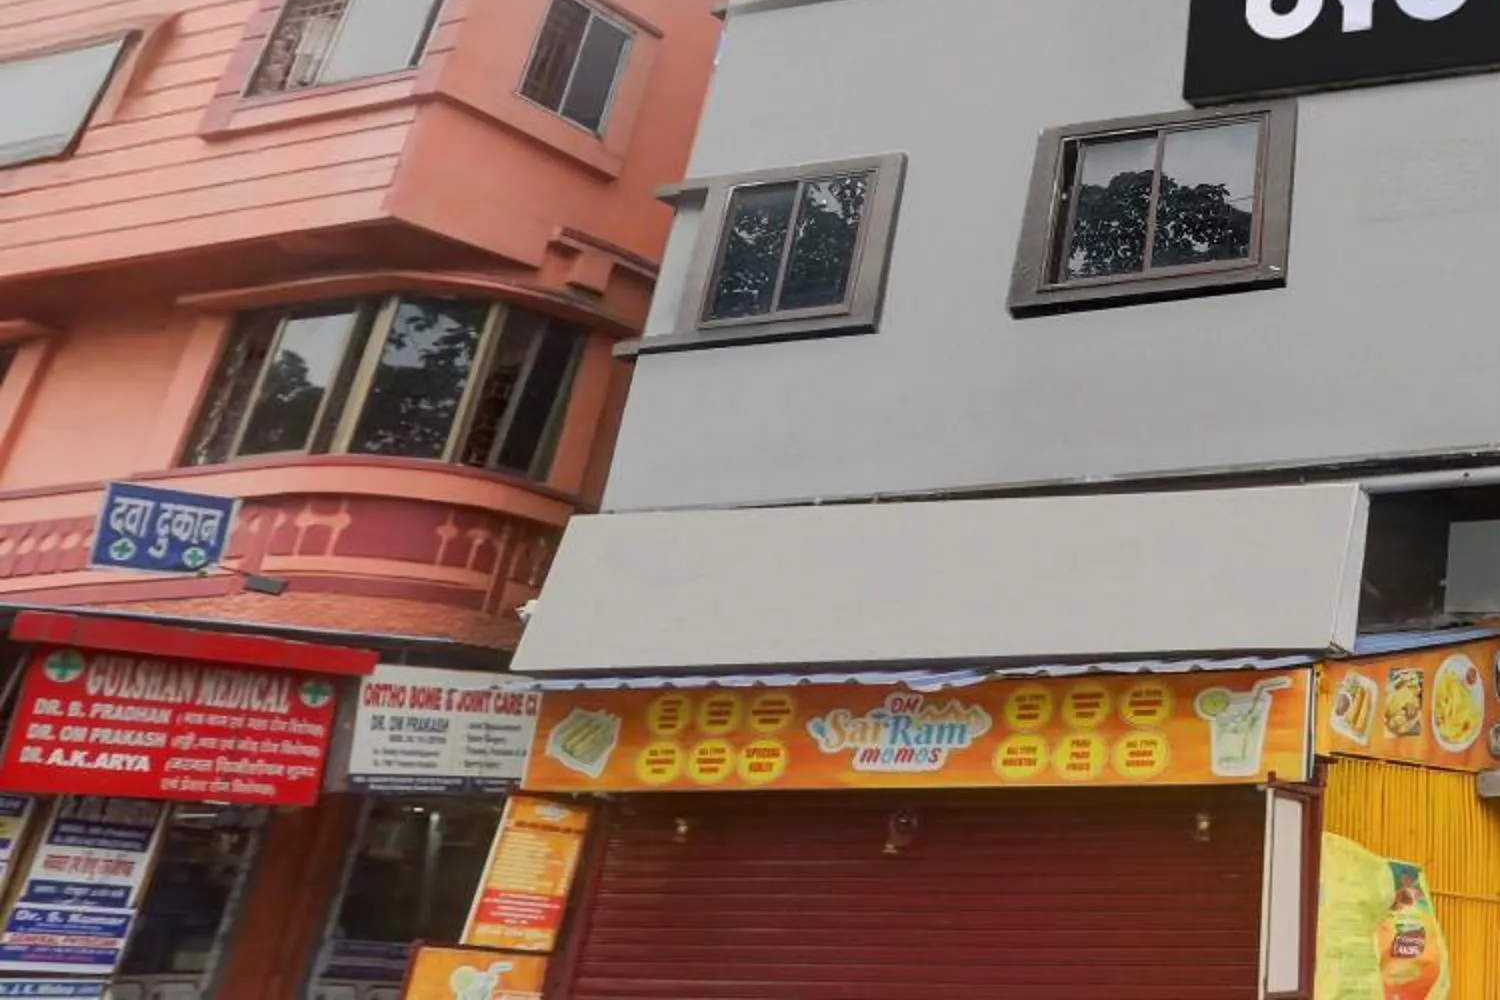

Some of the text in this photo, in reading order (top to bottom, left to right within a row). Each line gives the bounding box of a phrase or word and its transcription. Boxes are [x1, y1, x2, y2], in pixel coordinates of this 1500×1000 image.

[109, 496, 224, 559] दवा दुकान
[85, 655, 292, 714] GULSHAN MEDICAL
[363, 683, 407, 708] ORTHO
[409, 685, 443, 711] BONE
[457, 690, 493, 714] JOINT
[826, 710, 883, 747] Sai
[886, 714, 967, 746] Ram
[860, 747, 941, 764] momos
